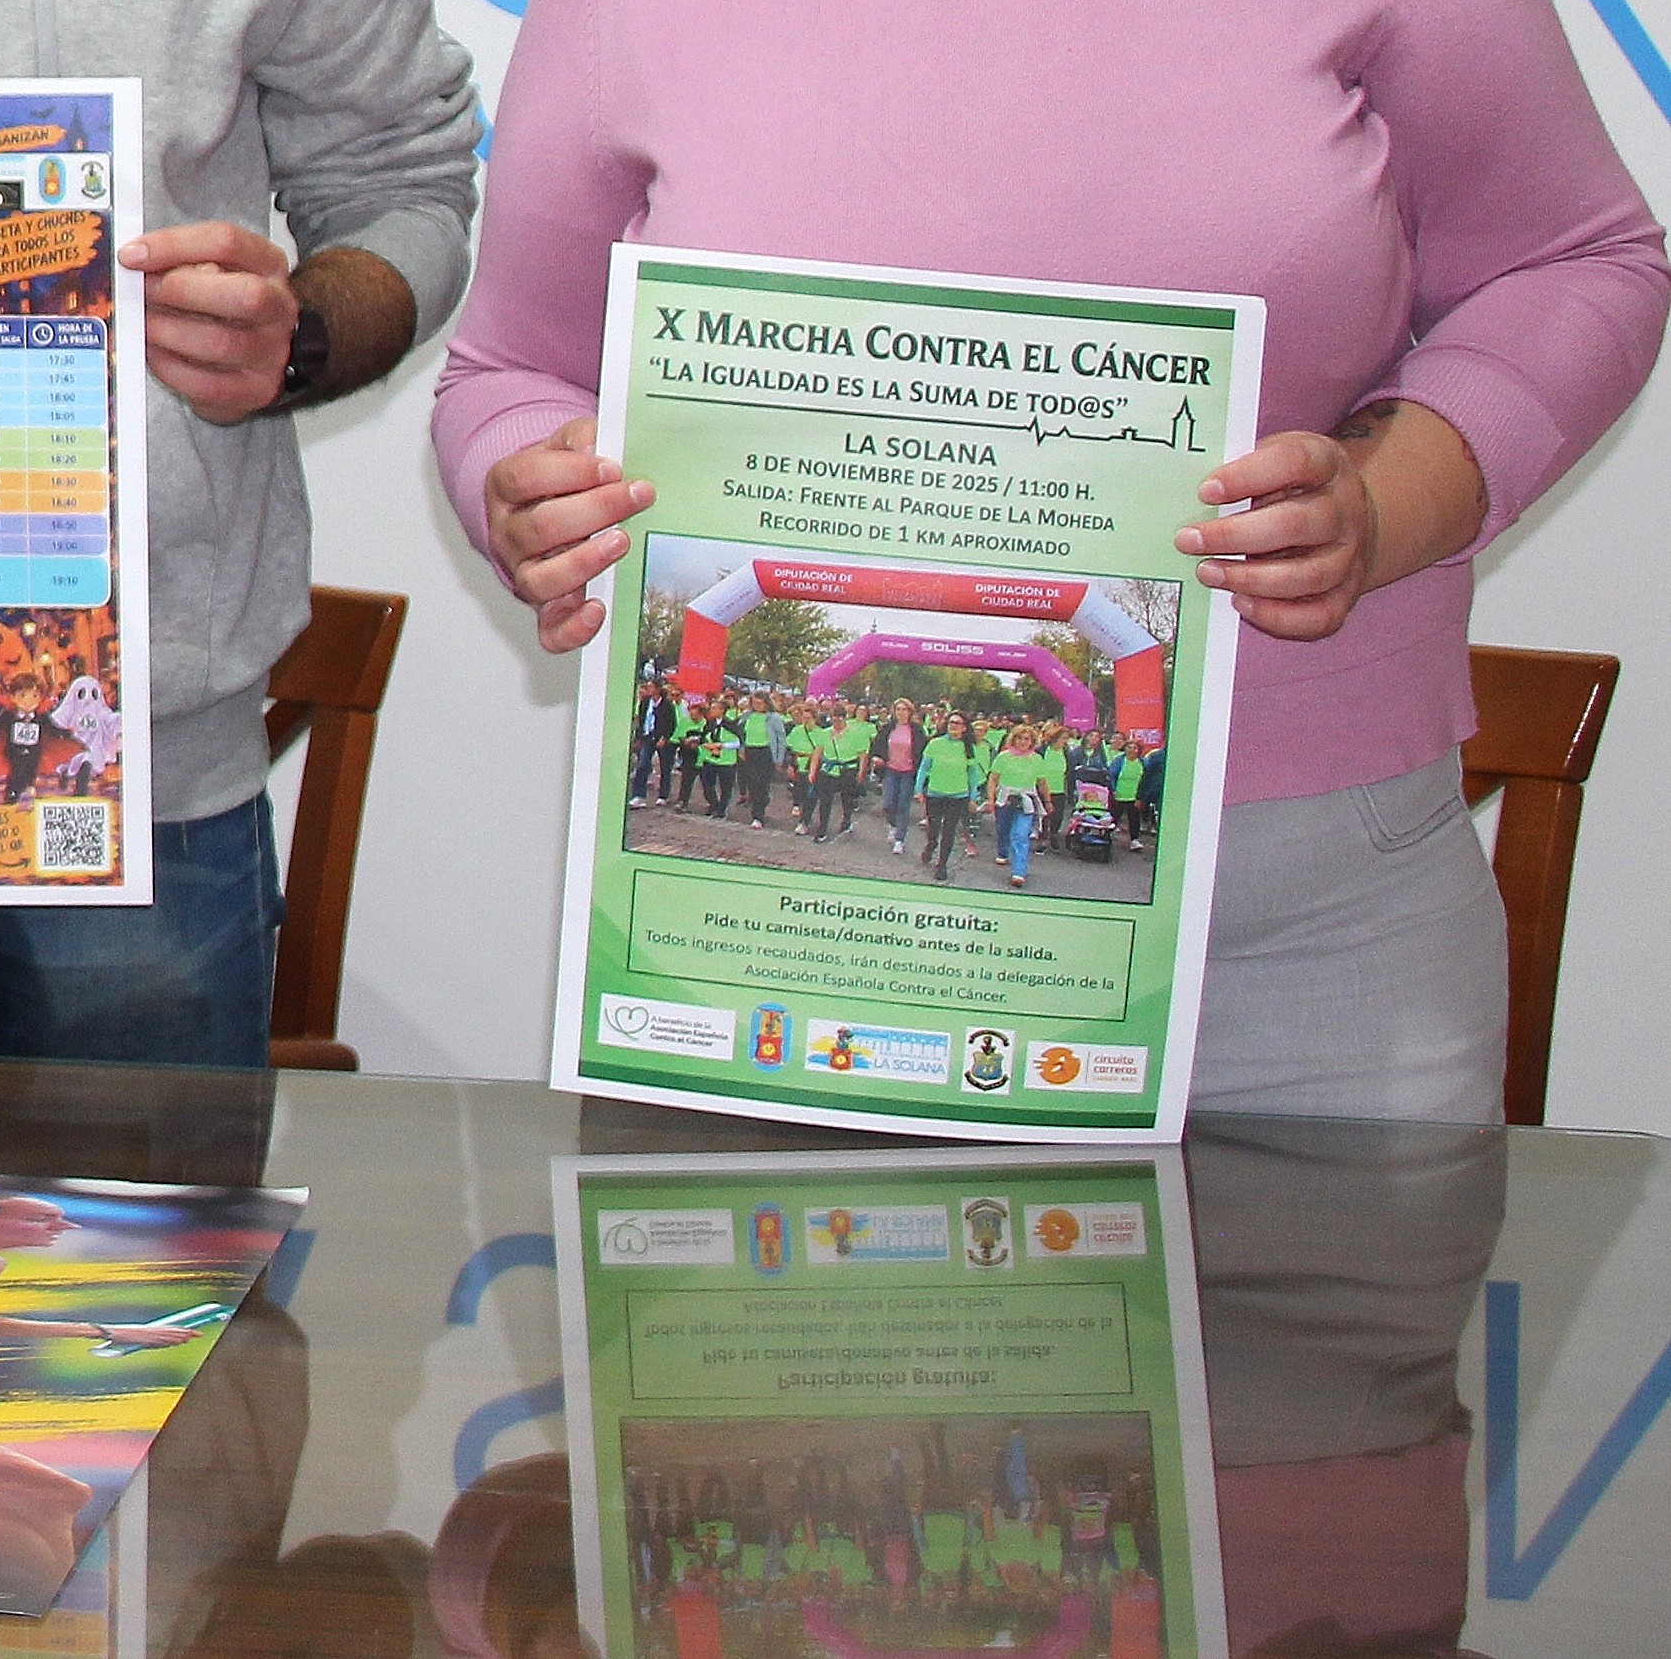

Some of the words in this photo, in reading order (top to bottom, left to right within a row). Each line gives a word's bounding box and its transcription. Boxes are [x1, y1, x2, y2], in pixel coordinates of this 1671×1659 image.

[26, 221, 34, 234] Y
[37, 211, 87, 231] CHUCHES
[15, 236, 49, 253] TODOS
[54, 229, 76, 244] LOS
[653, 306, 687, 342] X
[695, 310, 856, 357] MARCHA
[865, 324, 1012, 371] CONTRA
[1023, 342, 1060, 374] EL
[1071, 340, 1211, 386] CÁNCER
[702, 361, 829, 394] IGUALDAD
[837, 377, 864, 398] ES
[872, 379, 902, 401] LA
[909, 380, 979, 408] SUMA
[987, 390, 1019, 411] DE
[844, 432, 877, 456] LA
[885, 436, 998, 467] SOLANA
[746, 454, 757, 470] 8
[764, 455, 790, 473] DE
[797, 458, 915, 486] NOVIEMBRE
[921, 472, 948, 489] DE
[951, 473, 999, 494] 2025
[1018, 479, 1070, 500] 11:00
[1075, 484, 1095, 501] H.
[722, 479, 794, 502] SALIDA:
[800, 487, 868, 510] FRENTE
[872, 494, 895, 513] AL
[900, 496, 974, 521] PARQUE
[979, 507, 1001, 522] DE
[1008, 506, 1032, 525] LA
[1037, 508, 1116, 532] MOHEDA
[759, 511, 862, 539] RECORRIDO
[869, 525, 893, 541] DE
[899, 525, 909, 542] 1
[916, 529, 946, 546] KM
[951, 533, 1071, 556] APROXIMADO
[774, 568, 837, 582] DIPUTACIÓN
[839, 573, 854, 583] DE
[780, 580, 820, 591] CIUDAD
[822, 583, 846, 594] REAL
[974, 583, 1043, 598] DIPUTACIÓN
[1046, 587, 1061, 598] DE
[981, 596, 1024, 608] CIUDAD
[1027, 599, 1054, 609] REAL
[921, 642, 985, 655] SOLISS
[17, 729, 37, 741] 482
[779, 895, 909, 924] Participación
[914, 909, 999, 934] gratuita:
[704, 912, 739, 929] Pide
[745, 917, 762, 931] tu
[766, 921, 913, 949] camiseta/donativo
[918, 939, 960, 953] antes
[965, 941, 985, 955] de
[989, 942, 1002, 957] la
[1006, 945, 1058, 962] salida.
[646, 929, 687, 947] Todos
[692, 934, 752, 955] ingresos
[757, 945, 845, 967] recaudados,
[850, 953, 878, 968] irán
[883, 957, 962, 977] destinados
[967, 970, 975, 979] a
[980, 966, 993, 980] la
[997, 968, 1076, 988] delegación
[1079, 975, 1099, 989] de
[1102, 976, 1115, 990] la
[744, 963, 818, 983] Asociación
[823, 972, 885, 993] Española
[889, 980, 935, 996] Contra
[940, 986, 953, 997] el
[957, 986, 1008, 1003] Cáncer.
[873, 1058, 891, 1070] LA
[893, 1057, 947, 1075] SOLANA
[1094, 1055, 1135, 1065] circuito
